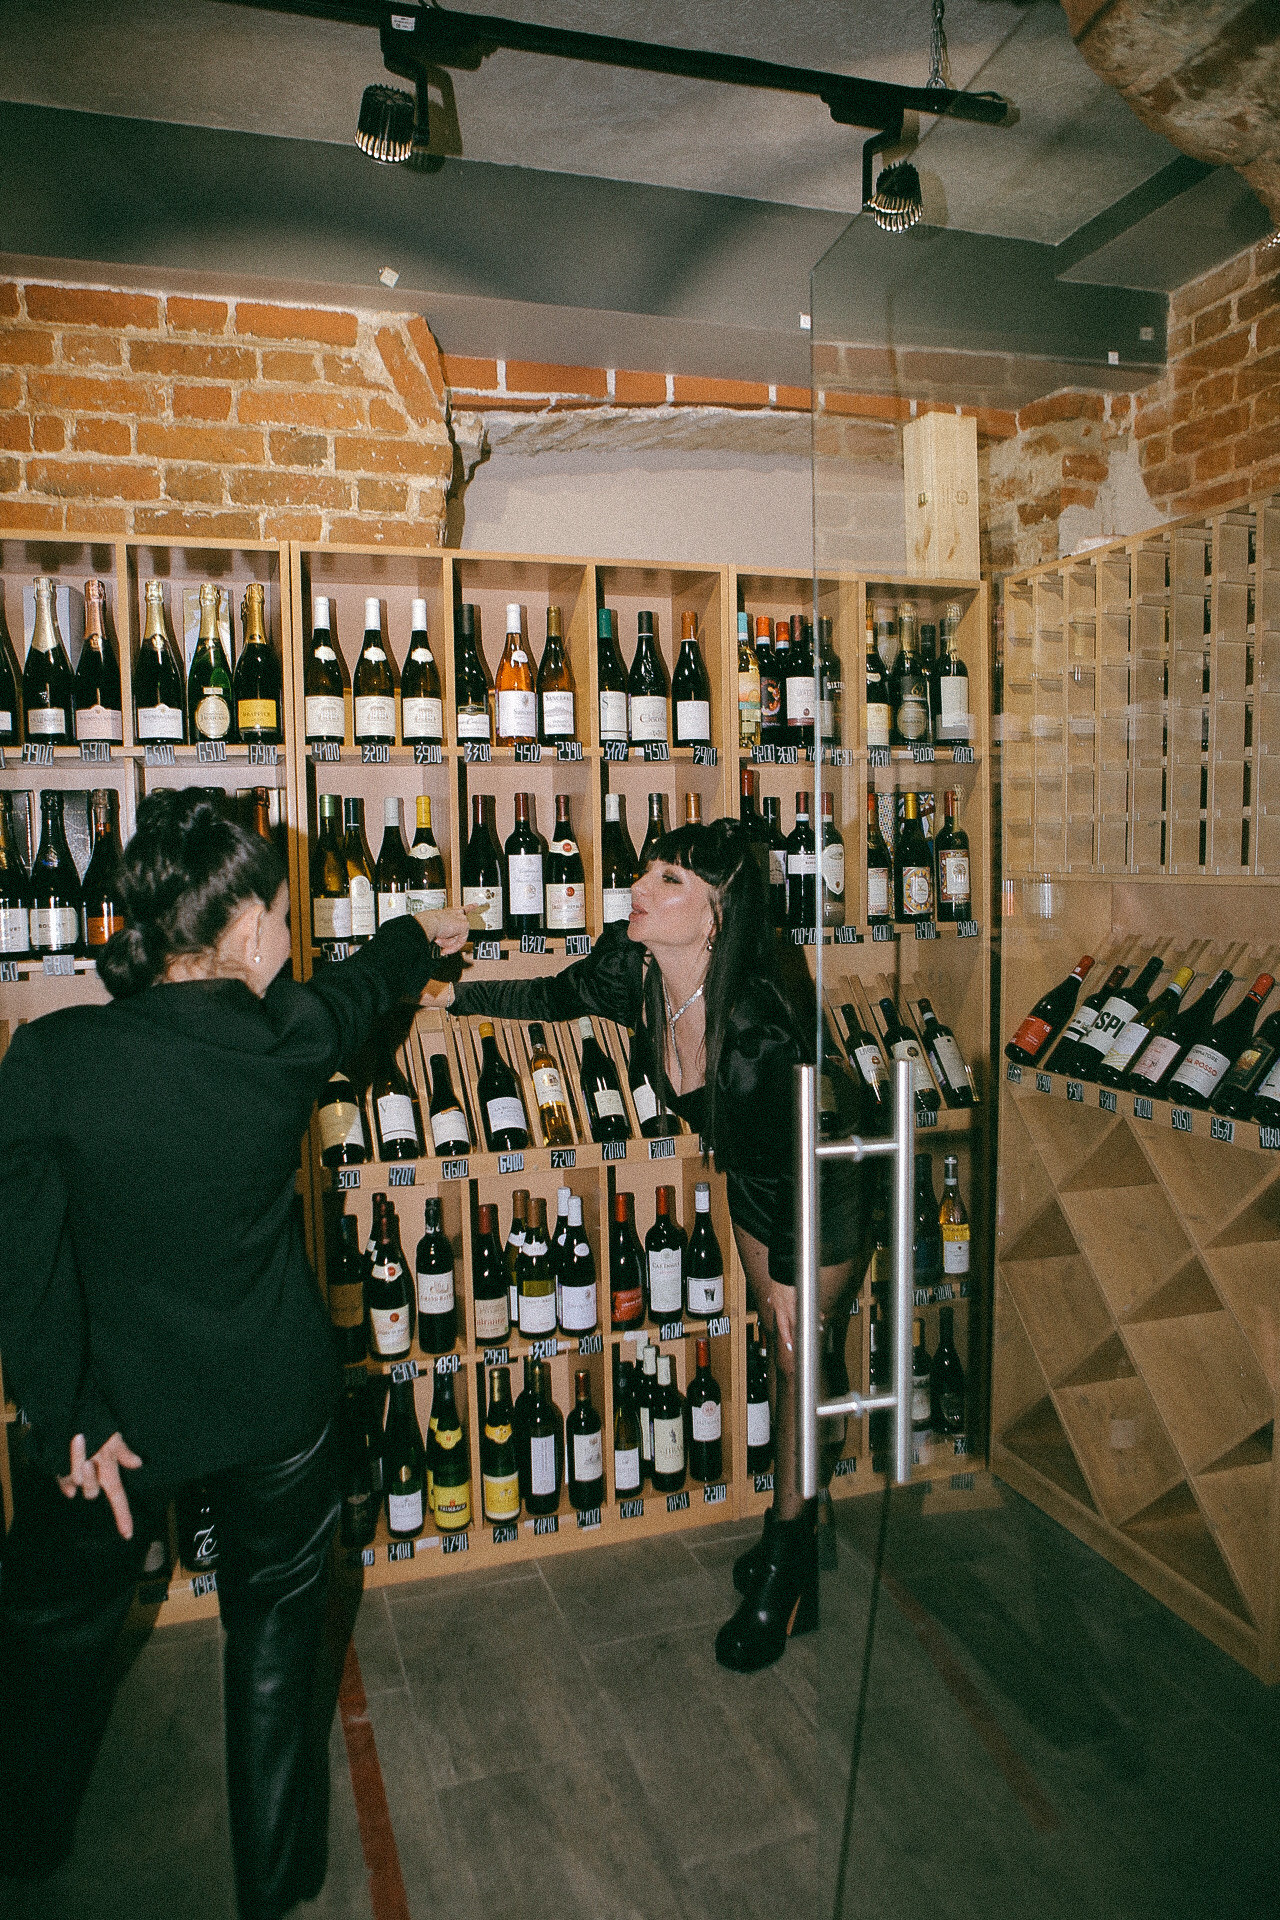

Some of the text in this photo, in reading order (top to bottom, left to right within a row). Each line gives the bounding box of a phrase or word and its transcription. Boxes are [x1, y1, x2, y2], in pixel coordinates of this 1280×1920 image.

[23, 743, 54, 766] 9900
[81, 742, 111, 763] 6900
[145, 745, 175, 766] 6500
[197, 742, 227, 763] 6500
[363, 745, 390, 763] 3200
[415, 745, 442, 764] 3900
[465, 743, 492, 762] 3300
[516, 743, 542, 762] 4500
[557, 742, 583, 761] 2990
[645, 742, 670, 761] 4500
[694, 745, 717, 767] 3900
[752, 743, 775, 763] 4200
[776, 745, 798, 764] 3600
[914, 747, 935, 763] 5000
[520, 935, 546, 954] 8300
[835, 926, 857, 944] 4000
[566, 935, 592, 956] 9900
[1193, 1060, 1217, 1077] ROSSO
[1172, 1109, 1192, 1132] 5050
[552, 1150, 576, 1168] 3200
[603, 1141, 626, 1160] 7000
[499, 1153, 524, 1174] 6900
[338, 1170, 360, 1188] 500
[390, 1167, 415, 1186] 4700
[534, 1338, 558, 1360] 3200
[704, 1484, 726, 1503] 2200
